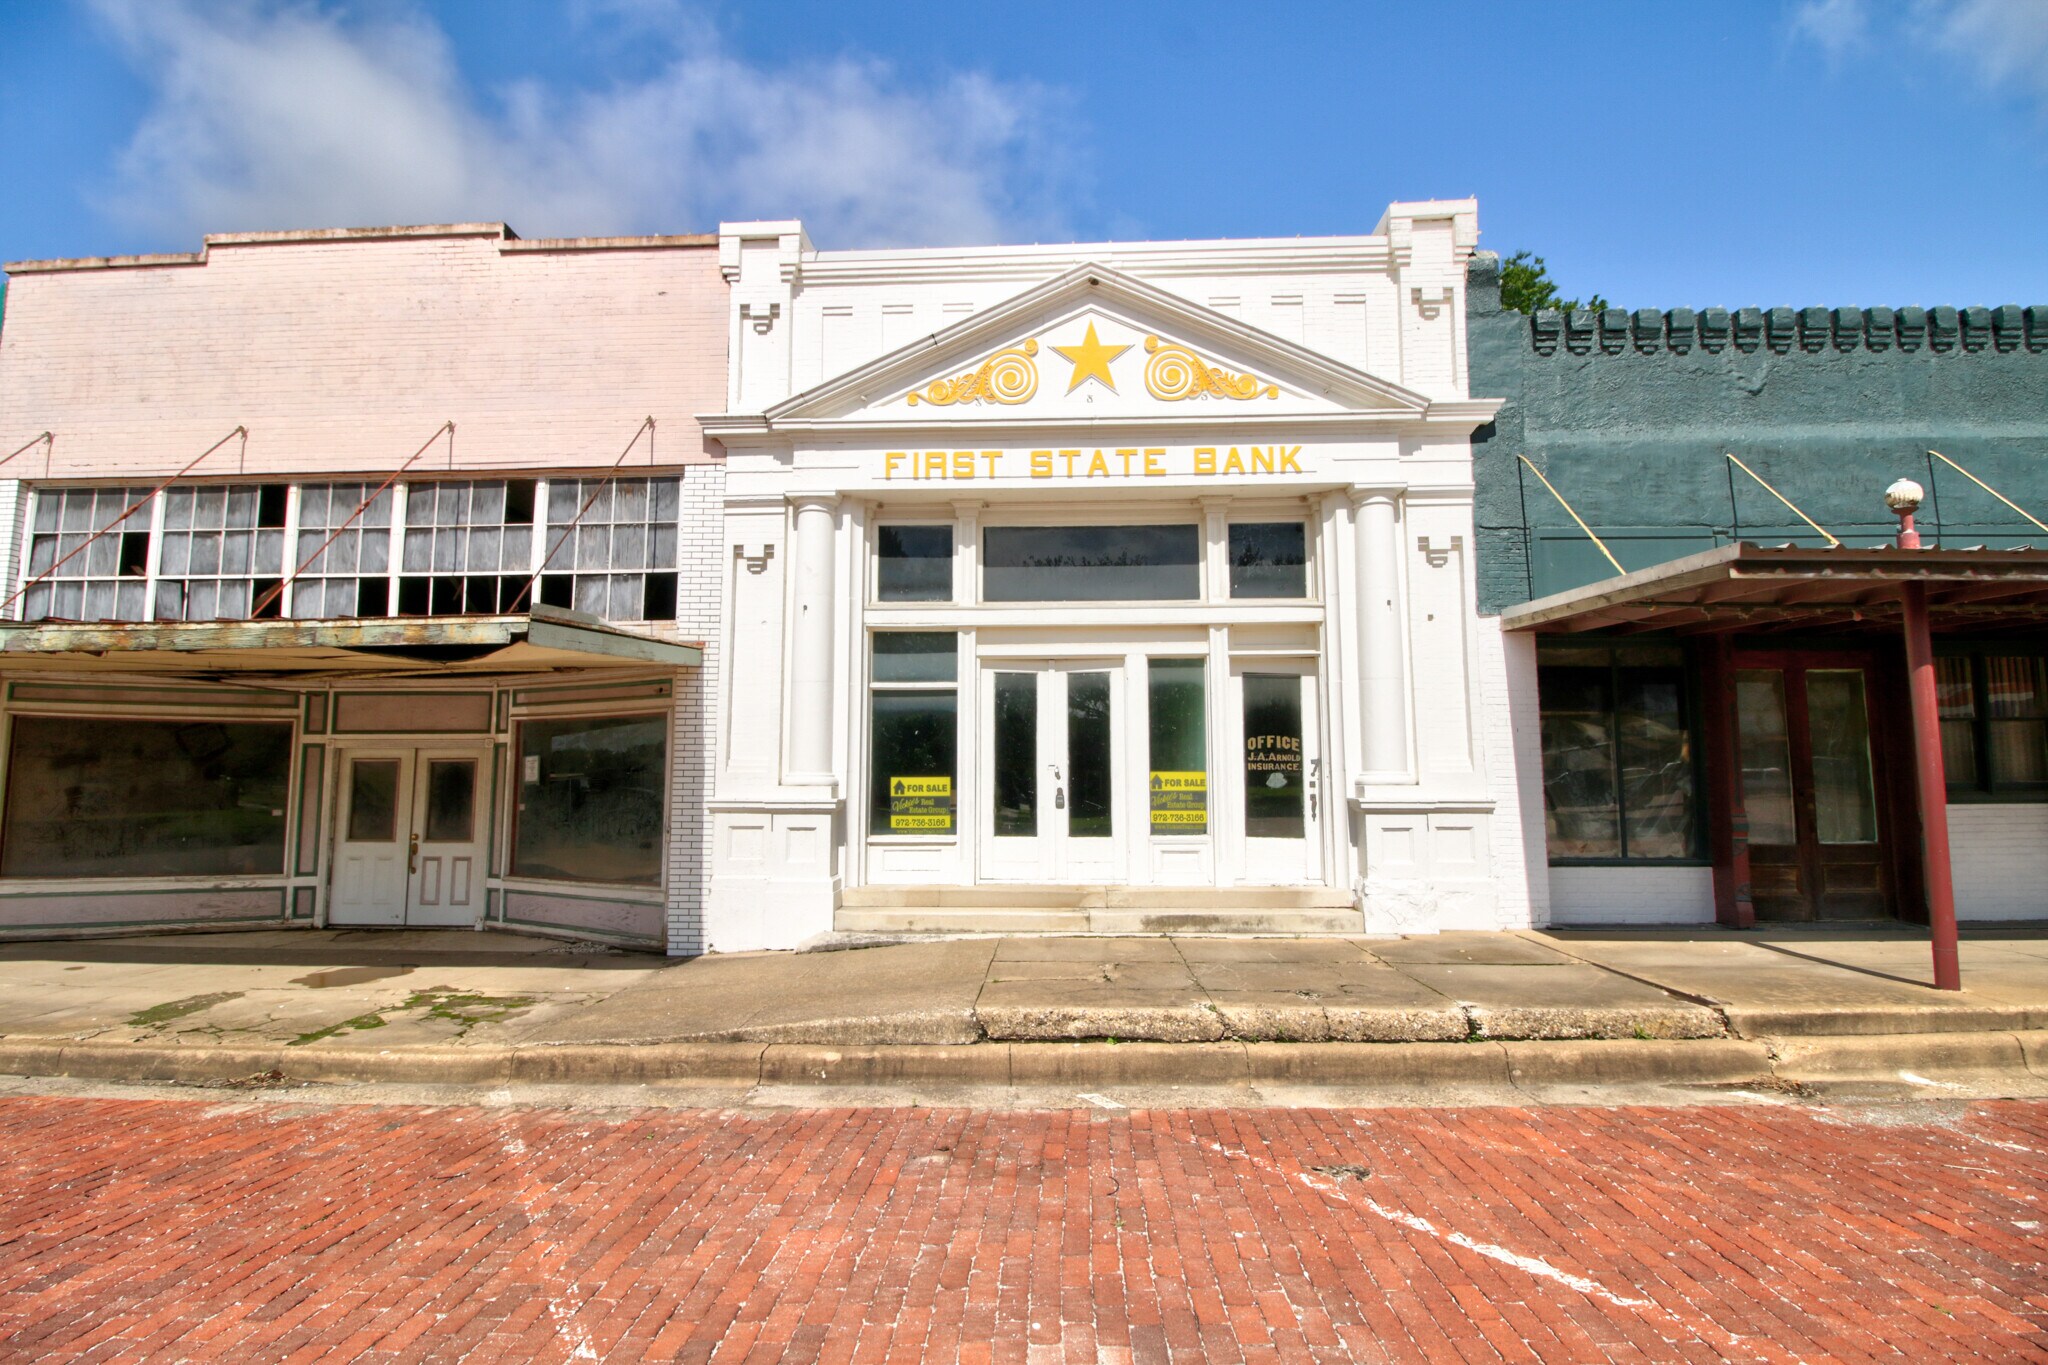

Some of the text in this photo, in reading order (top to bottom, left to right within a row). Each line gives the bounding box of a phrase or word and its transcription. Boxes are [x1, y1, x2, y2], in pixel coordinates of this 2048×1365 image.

[885, 445, 1302, 480] FIRST STATE BANK
[1247, 735, 1300, 751] OFFICE
[1164, 779, 1206, 787] FOR SALE
[907, 784, 948, 792] FOR SALE
[921, 798, 935, 806] Real
[1167, 801, 1186, 809] Estate
